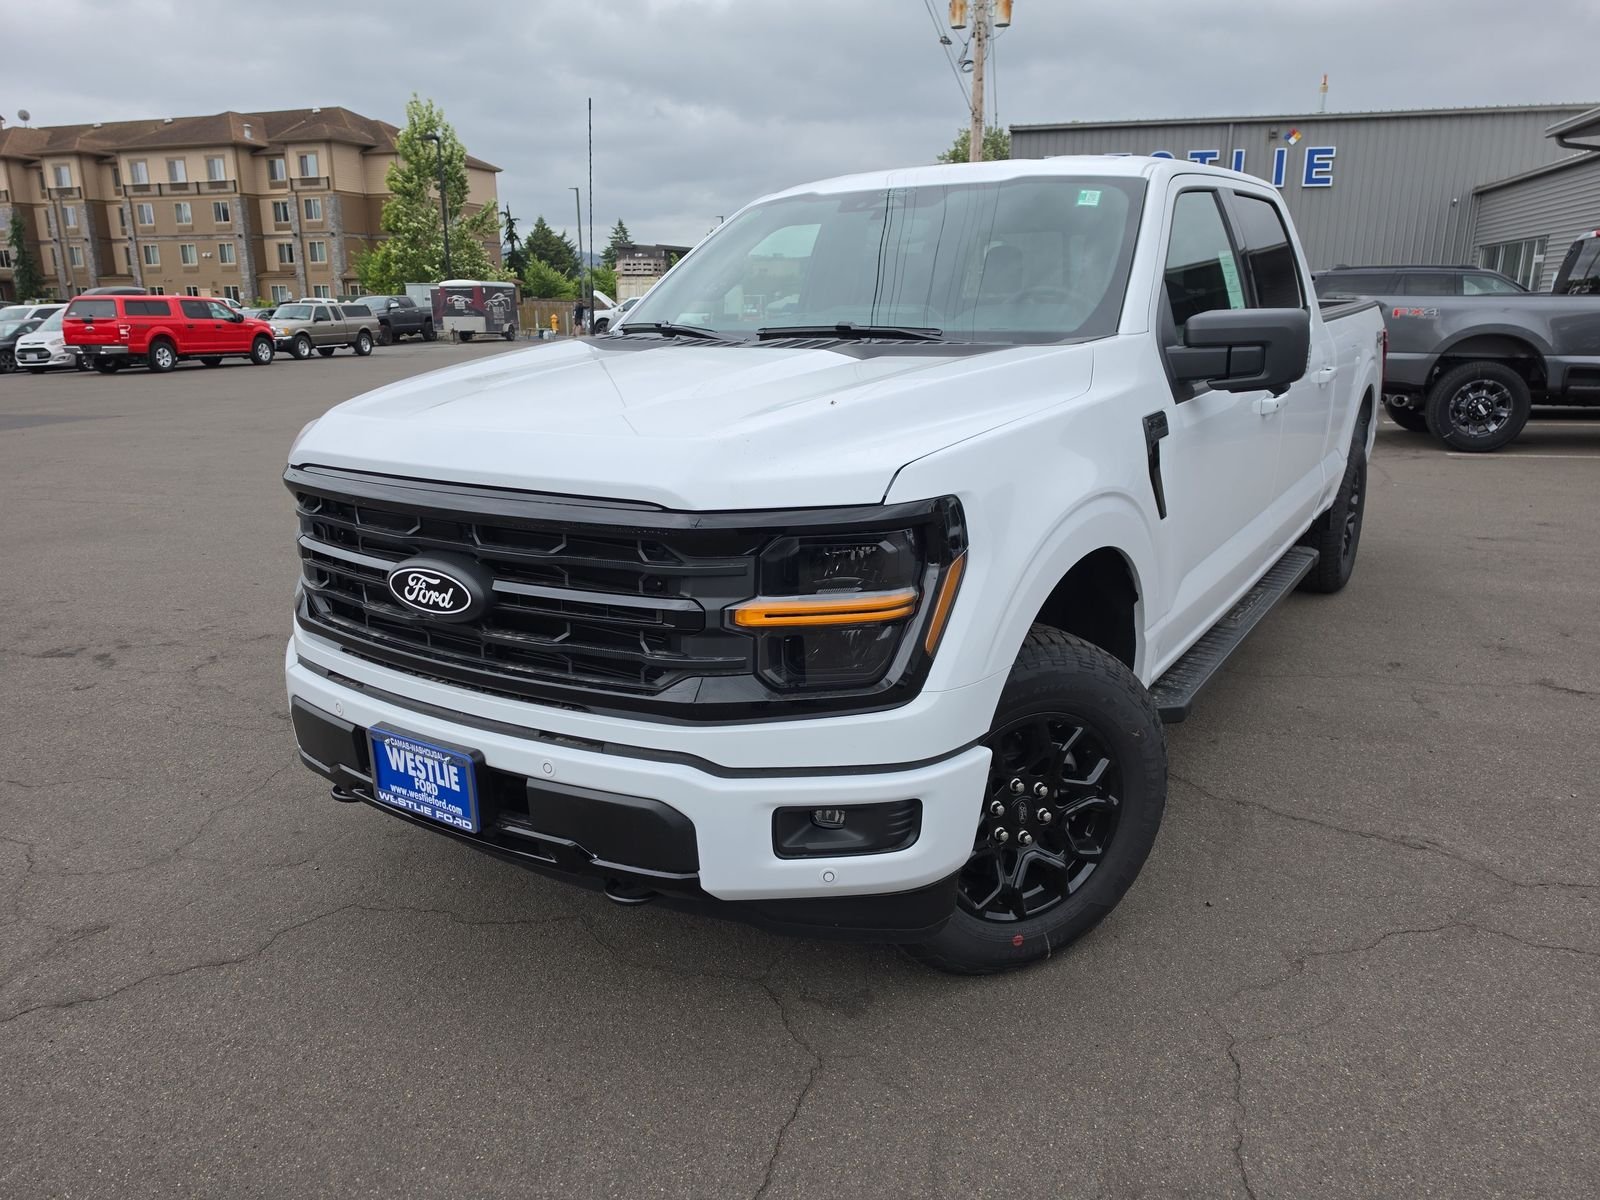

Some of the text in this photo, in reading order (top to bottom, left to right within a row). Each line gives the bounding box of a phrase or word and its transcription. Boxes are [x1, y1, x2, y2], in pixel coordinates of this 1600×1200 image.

[1392, 307, 1440, 319] FX4
[404, 573, 454, 608] Ford
[384, 743, 460, 792] WESTLIE
[390, 784, 463, 815] www.westlieford.com
[414, 777, 438, 796] FORD
[378, 791, 472, 830] WESTLIE FORD
